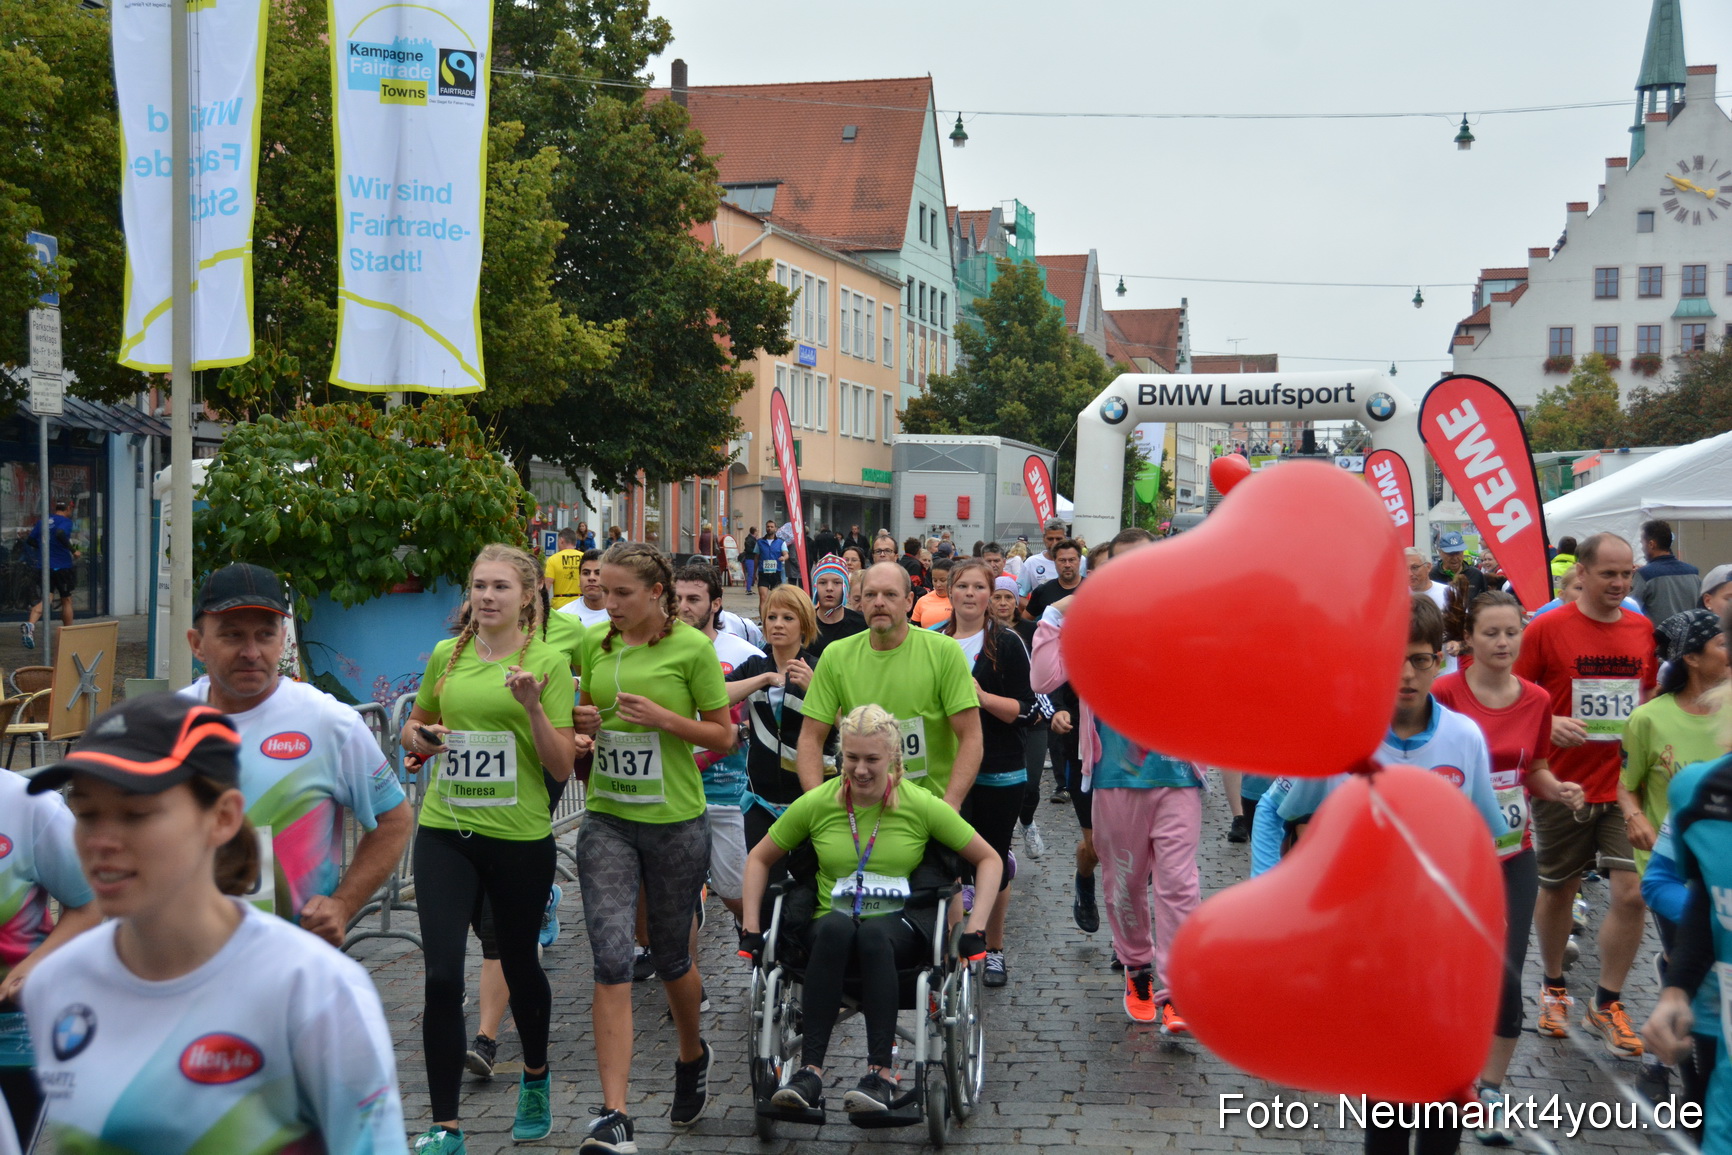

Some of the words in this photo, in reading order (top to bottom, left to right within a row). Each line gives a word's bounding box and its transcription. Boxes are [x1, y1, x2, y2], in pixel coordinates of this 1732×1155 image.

[350, 42, 424, 63] Kampagne
[350, 57, 432, 80] Fairtrade
[381, 83, 426, 99] Towns
[440, 86, 475, 97] FAIRTRADE
[347, 174, 392, 201] Wir
[396, 178, 453, 205] sind
[349, 211, 471, 241] Fairtrade-
[349, 247, 423, 273] Stadt!
[32, 320, 59, 334] Parkschein
[1138, 383, 1213, 406] BMW
[1220, 382, 1356, 409] Laufsport
[776, 408, 804, 550] REWE
[1435, 398, 1532, 544] REWE
[1028, 465, 1054, 524] EWE
[1371, 458, 1409, 527] REWE
[547, 535, 555, 547] P
[1580, 694, 1634, 717] 5313
[469, 734, 508, 744] BOCK
[615, 734, 652, 744] BOCK
[1584, 724, 1616, 732] ndreas
[267, 738, 307, 753] Hervis
[446, 749, 506, 778] 5121
[597, 744, 654, 777] 5137
[454, 784, 496, 797] Theresa
[611, 780, 638, 794] Elena
